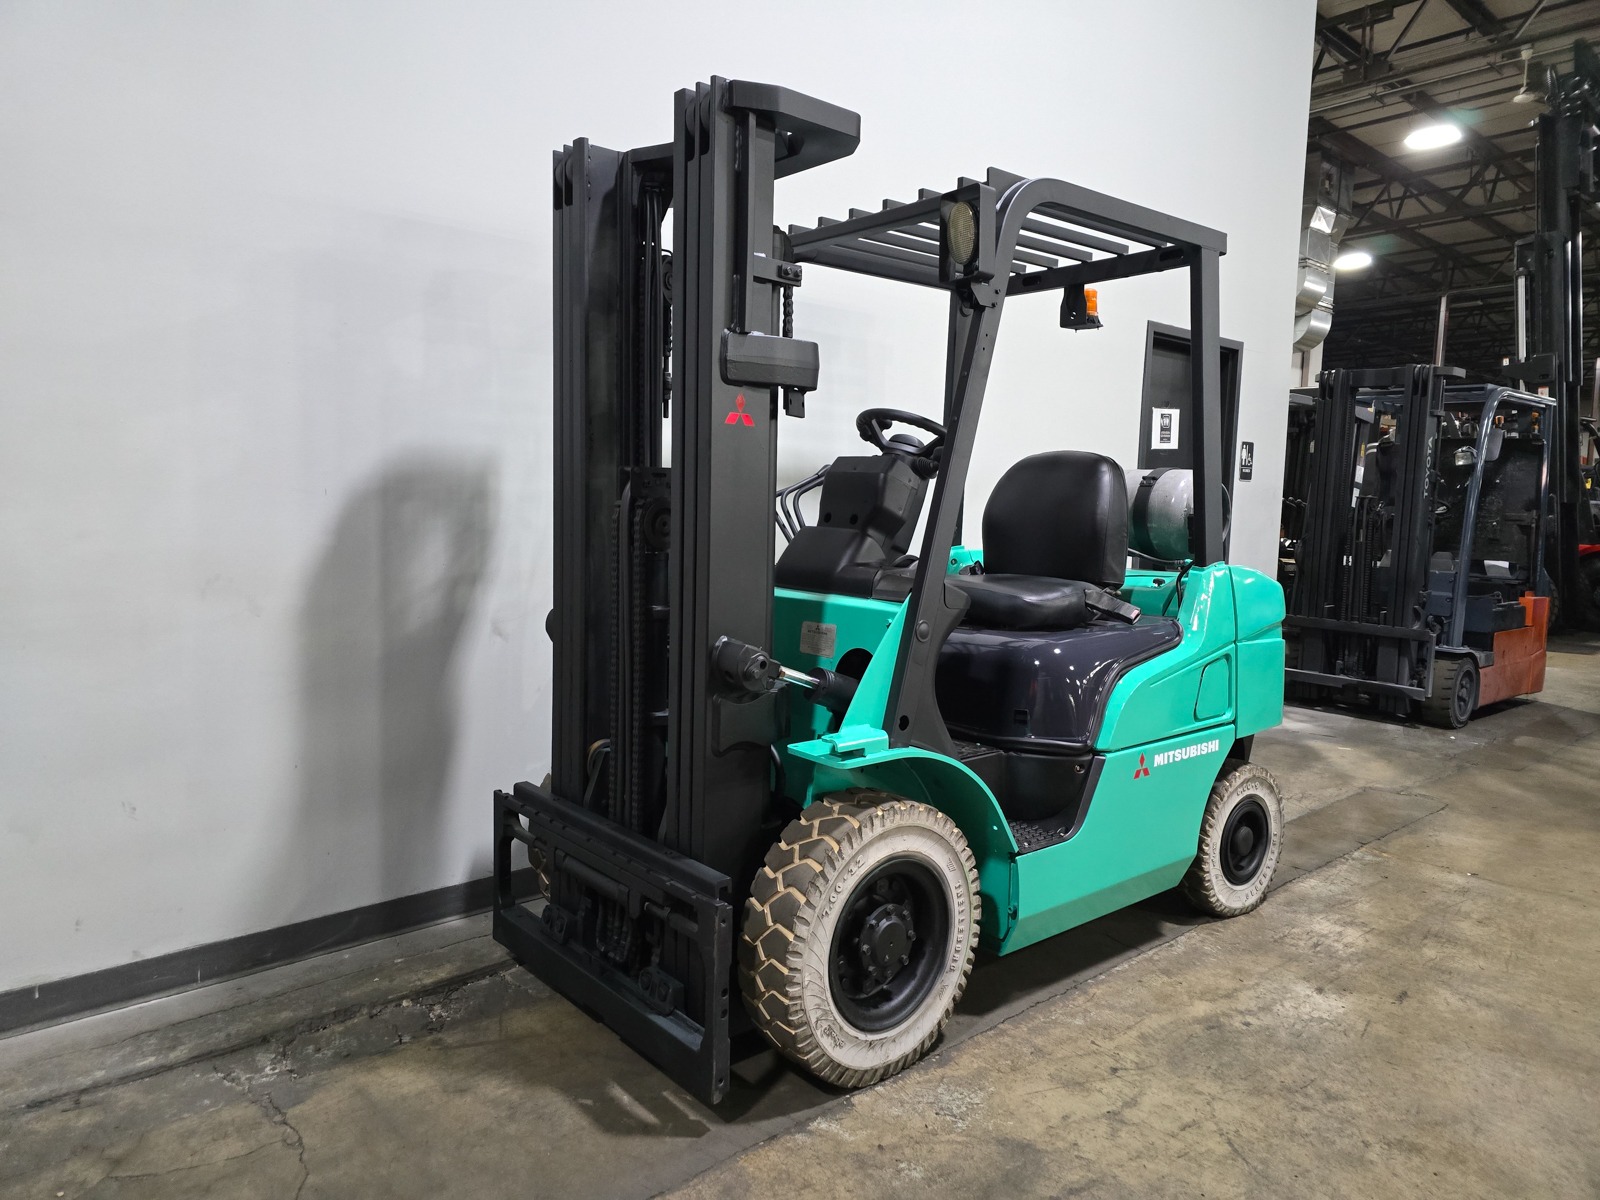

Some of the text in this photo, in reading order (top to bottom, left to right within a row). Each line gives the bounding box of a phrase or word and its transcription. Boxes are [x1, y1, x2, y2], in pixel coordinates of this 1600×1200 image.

[1423, 436, 1433, 499] TOYOTA
[1153, 739, 1220, 767] MITSUBISHI
[950, 880, 965, 973] TRELLEBORG
